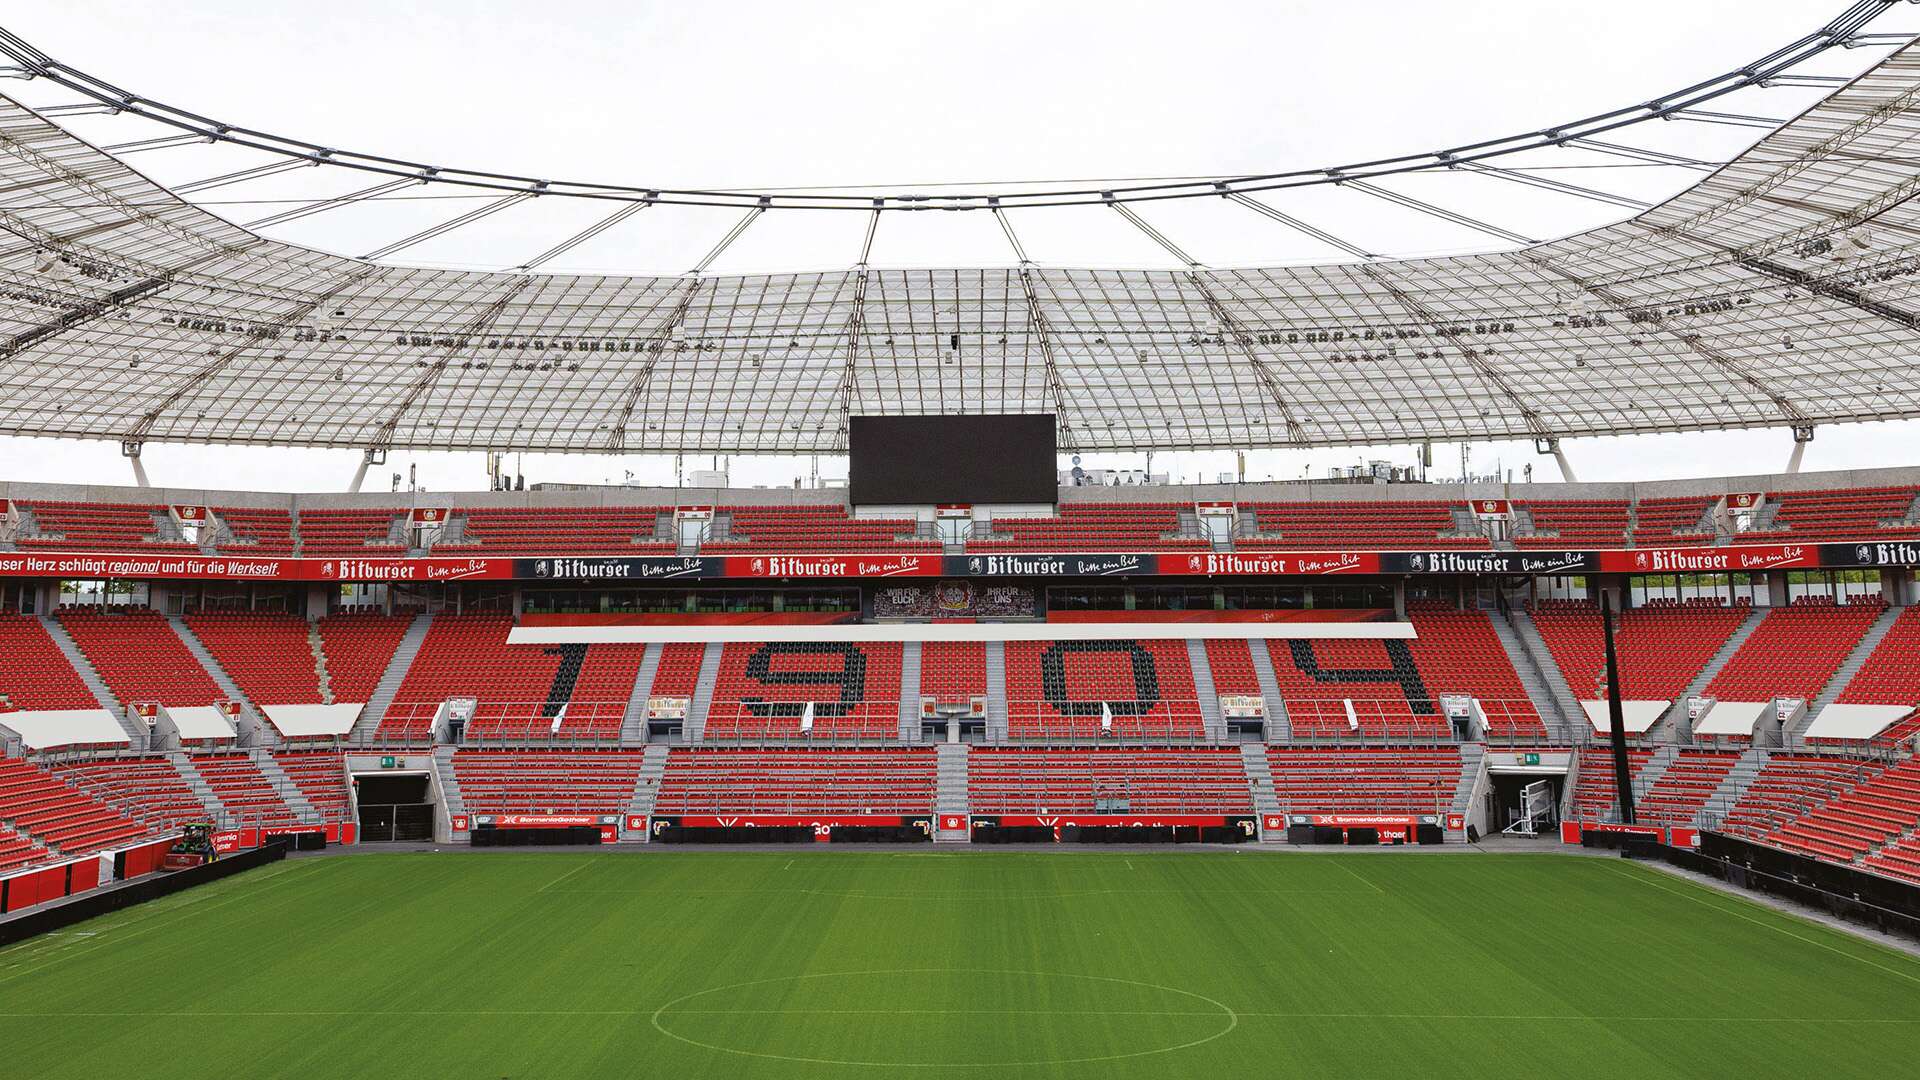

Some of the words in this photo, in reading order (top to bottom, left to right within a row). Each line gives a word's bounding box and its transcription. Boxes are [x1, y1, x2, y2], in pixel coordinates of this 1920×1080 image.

[1207, 554, 1285, 573] Bitburger
[1298, 559, 1321, 573] Bitte
[1323, 559, 1341, 568] ein
[1341, 553, 1360, 565] Bit
[1428, 552, 1509, 572] Bitburger
[1522, 558, 1546, 571] Bitte
[1547, 558, 1565, 567] ein
[1565, 552, 1584, 564] Bit
[1652, 551, 1728, 570] Bitburger
[1741, 554, 1764, 567] Bitte
[1766, 553, 1784, 562] ein
[1784, 546, 1803, 559] Bit
[1876, 543, 1920, 565] Bitb
[0, 560, 24, 571] ser
[26, 558, 56, 571] Herz
[59, 558, 107, 575] schlägt
[108, 559, 161, 575] regional
[162, 560, 185, 574] und
[187, 561, 205, 574] für
[207, 561, 225, 574] die
[226, 561, 280, 576] Werkself.
[338, 560, 415, 579] Bitburger
[427, 565, 449, 578] Bitte
[451, 564, 468, 574] ein
[469, 559, 488, 571] Bit
[553, 559, 630, 578] Bitburger
[642, 563, 664, 577] Bitte
[666, 563, 683, 572] ein
[683, 558, 702, 570] Bit
[769, 557, 846, 576] Bitburger
[858, 562, 881, 575] Bitte
[883, 562, 900, 571] ein
[900, 556, 919, 568] Bit
[987, 555, 1065, 575] Bitburger
[1078, 560, 1101, 574] Bitte
[1102, 560, 1120, 569] ein
[1120, 554, 1139, 567] Bit
[886, 588, 903, 597] WIR
[903, 586, 920, 597] FÜR
[892, 595, 914, 604] EUCH
[987, 587, 1001, 596] IHR
[1002, 585, 1019, 596] FÜR
[994, 594, 1012, 603] UNS
